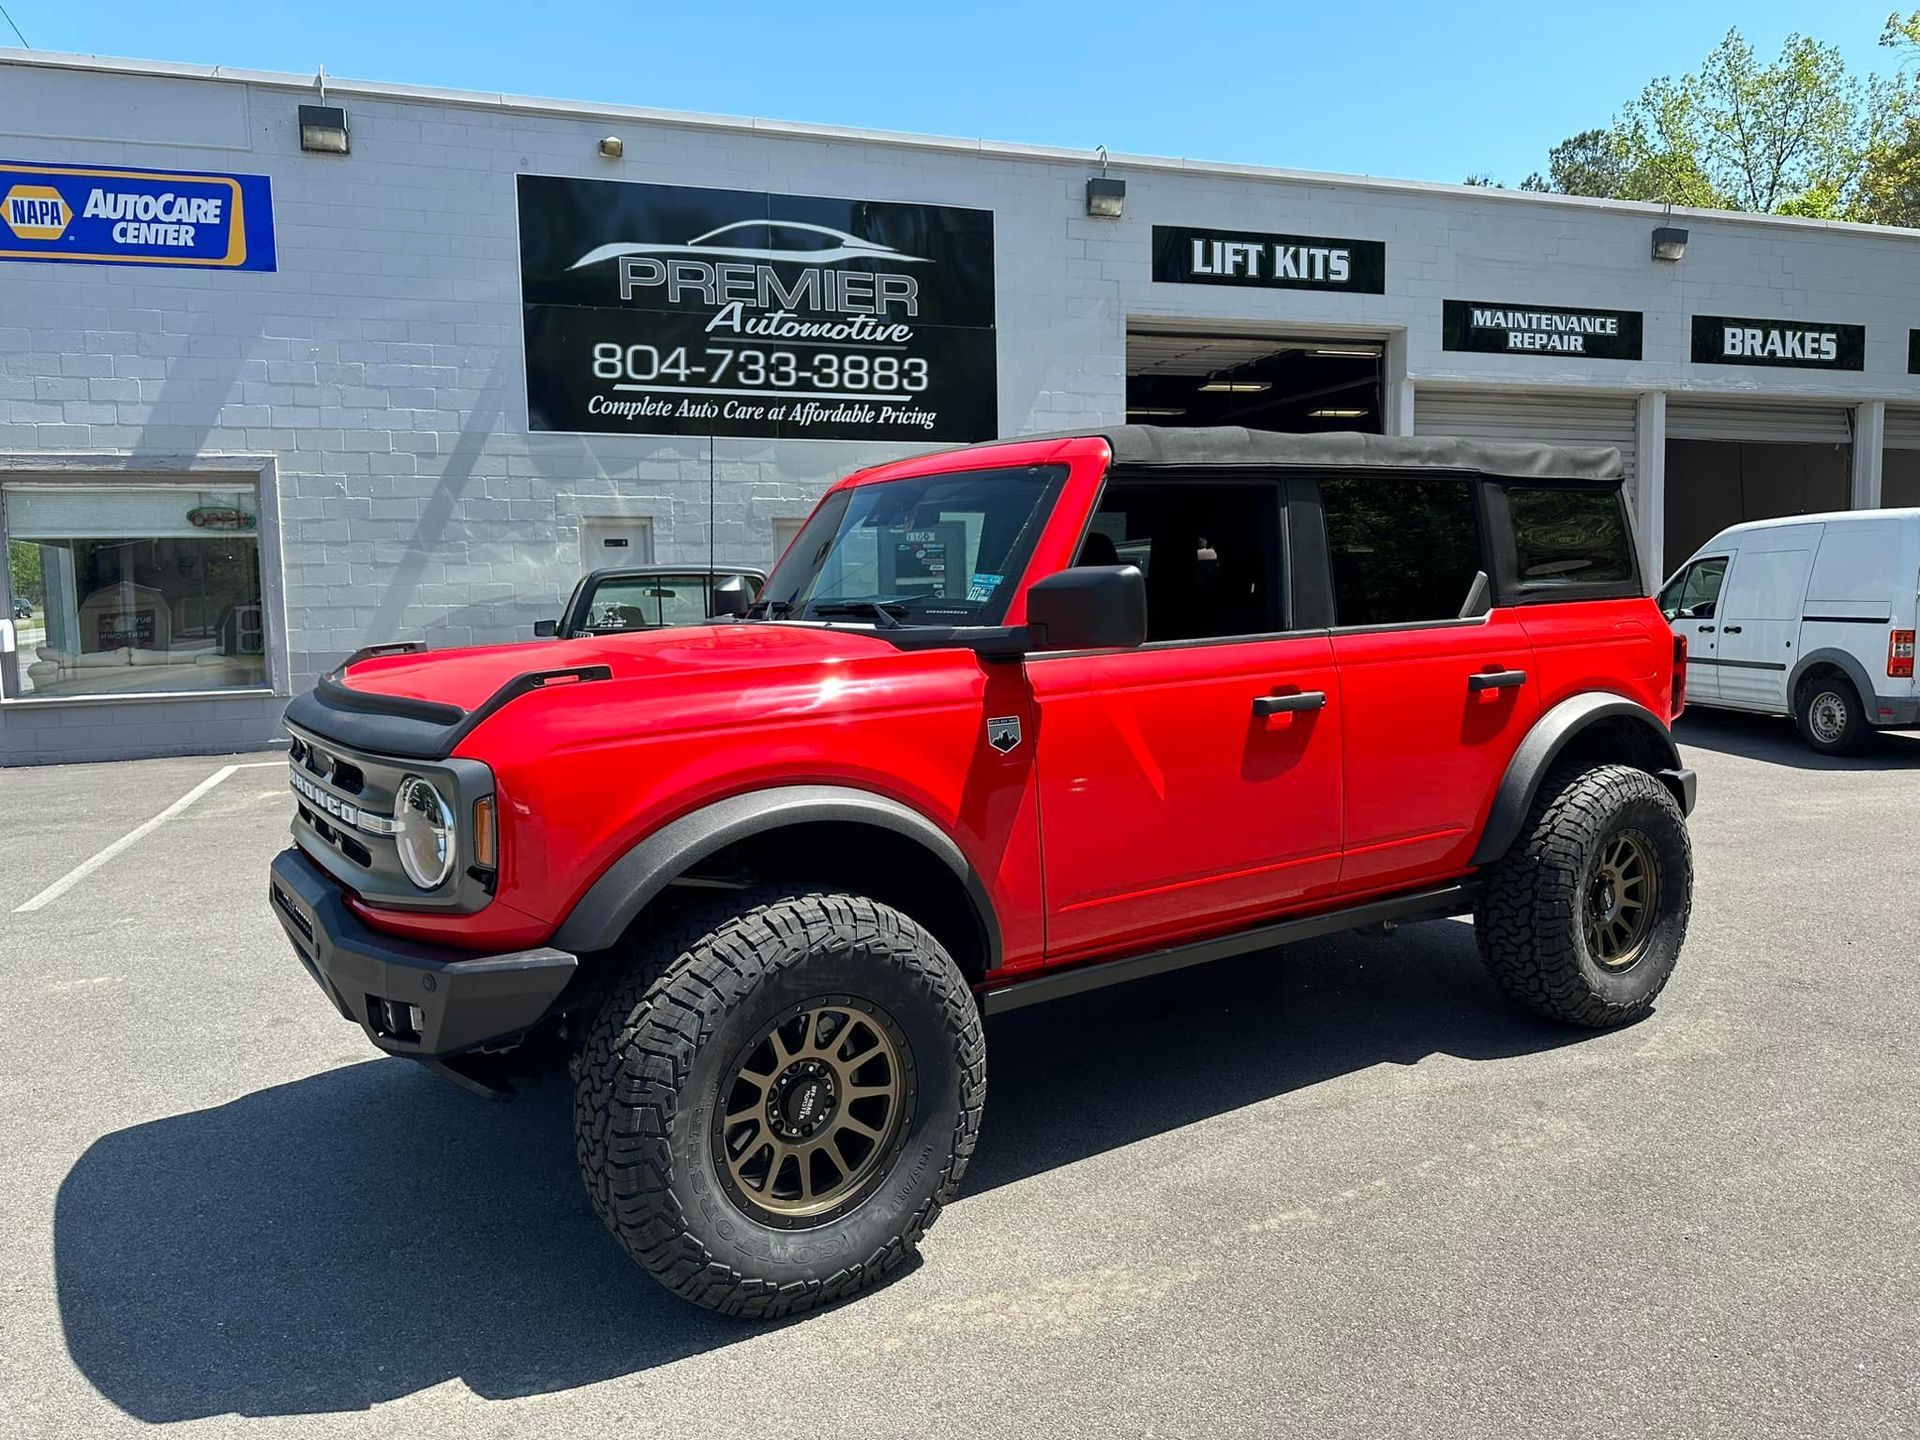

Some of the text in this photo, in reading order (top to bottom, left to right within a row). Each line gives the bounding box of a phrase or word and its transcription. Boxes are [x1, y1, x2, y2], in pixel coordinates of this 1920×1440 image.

[12, 199, 62, 226] NAPA
[82, 188, 222, 225] AUTOCARE
[112, 222, 195, 246] CENTER
[1191, 239, 1350, 283] LIFT KITS
[619, 256, 919, 317] PREMIER
[705, 301, 914, 342] Automotive
[1472, 308, 1618, 335] MAINTENANCE
[1507, 331, 1584, 353] REPAIR
[1723, 327, 1838, 360] BRAKES
[592, 342, 929, 392] 804-733-3883
[588, 395, 937, 430] Complete Auto Care at Affordable Pricing
[289, 767, 358, 826] BRONCO
